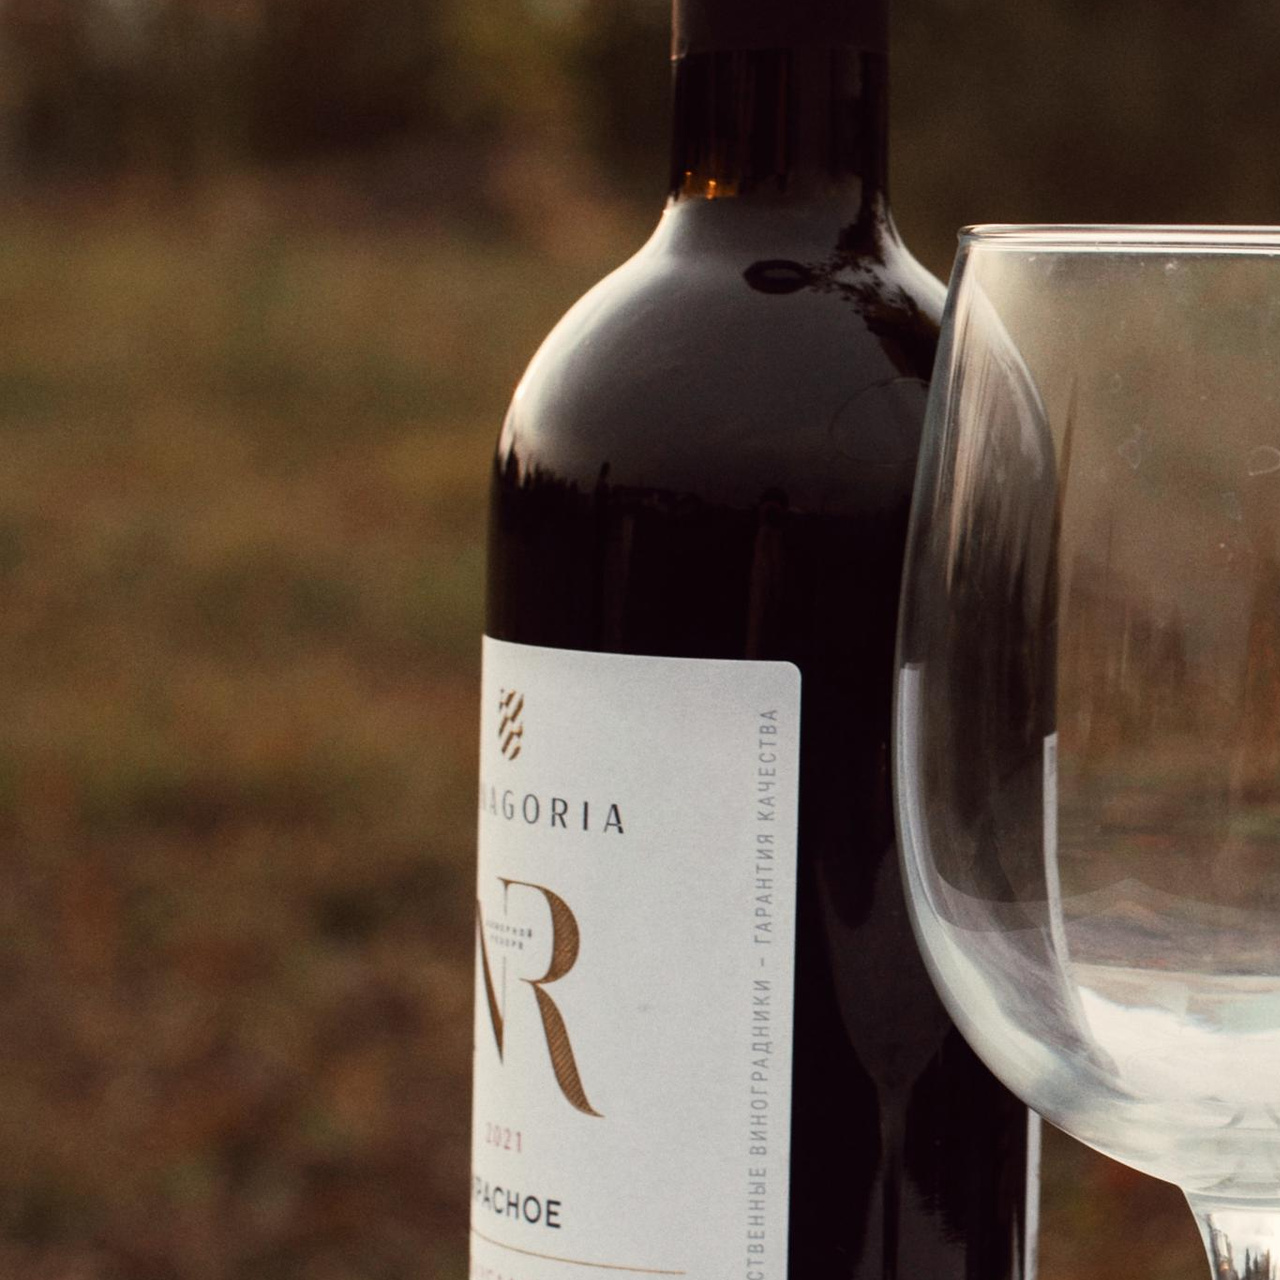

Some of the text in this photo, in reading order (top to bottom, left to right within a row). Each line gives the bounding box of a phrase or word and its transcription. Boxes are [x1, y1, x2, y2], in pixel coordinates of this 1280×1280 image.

[481, 783, 625, 835] AGORIA
[756, 708, 778, 821] КАЧЕСТВА
[754, 833, 775, 945] ГАРАНТИЯ
[748, 979, 773, 1156] ВИНОГРАДНИКИ
[473, 1176, 562, 1229] РАСНОЕ
